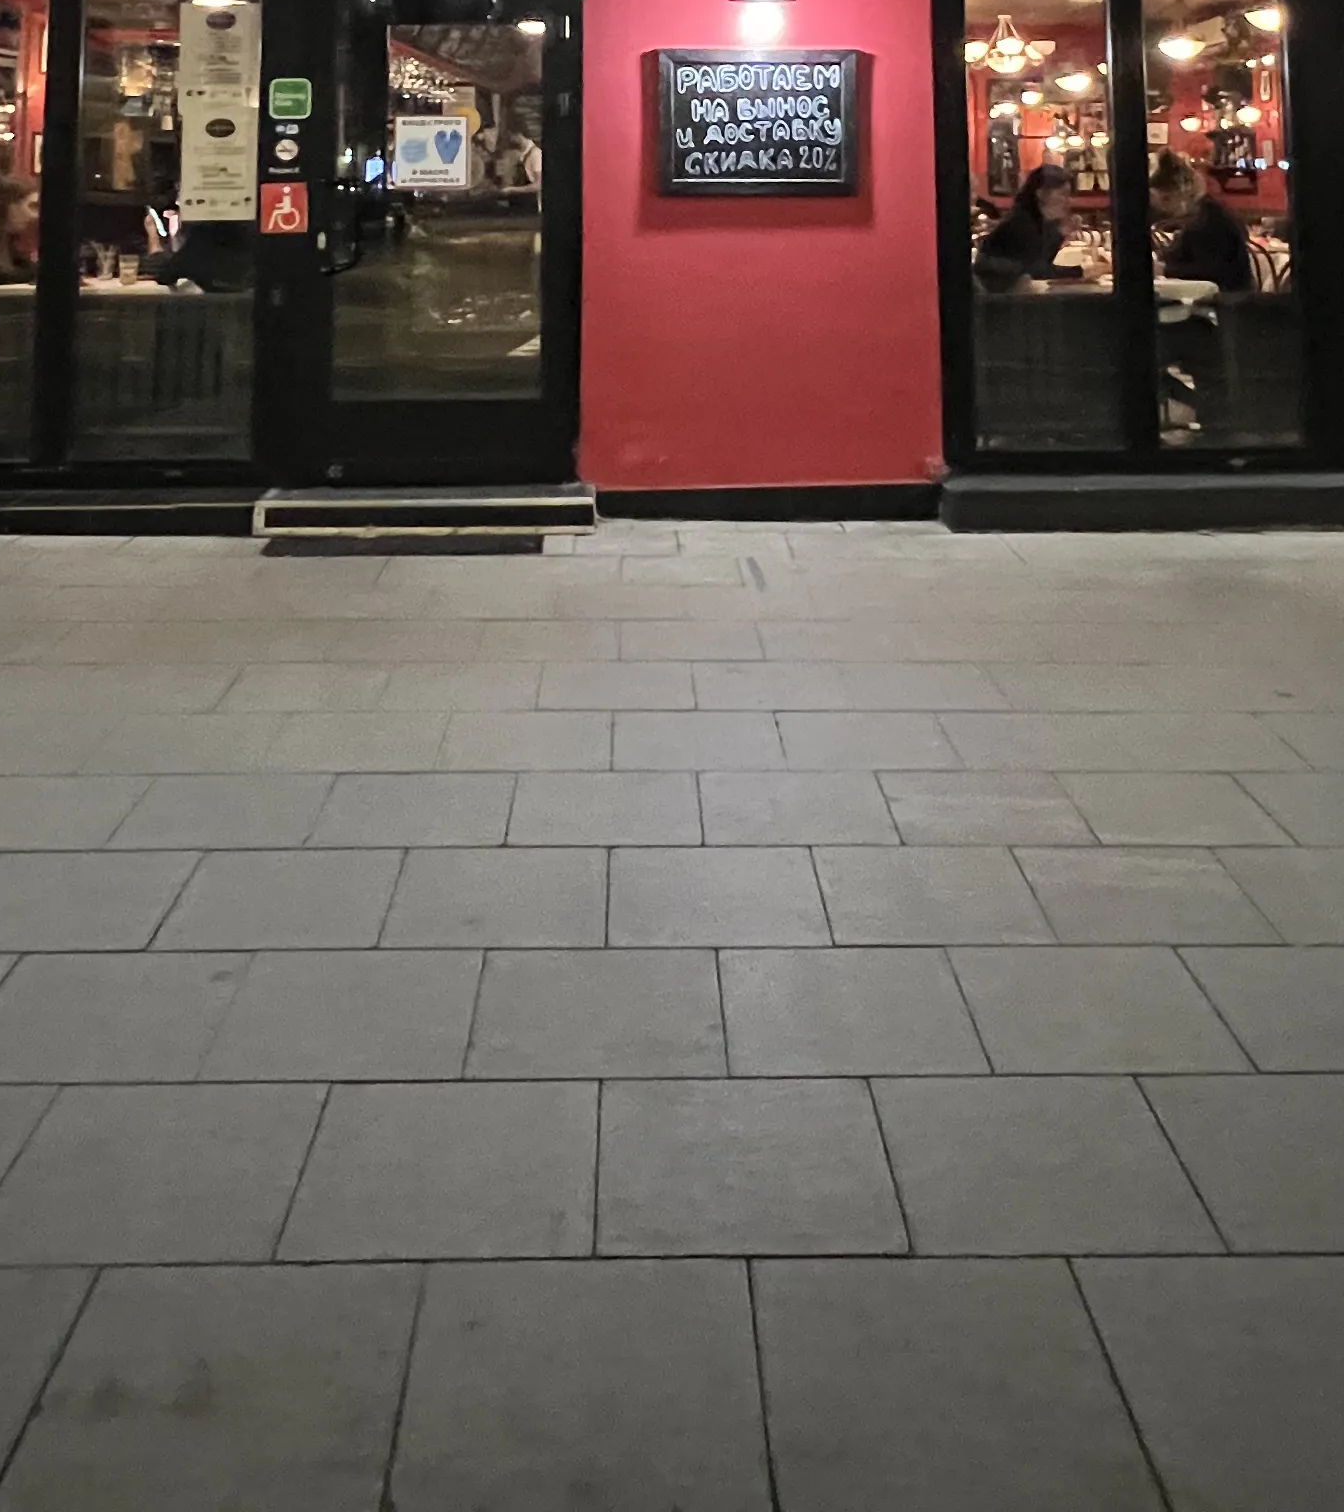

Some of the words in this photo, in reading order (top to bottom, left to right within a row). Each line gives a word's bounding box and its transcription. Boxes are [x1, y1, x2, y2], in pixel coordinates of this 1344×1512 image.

[676, 64, 841, 94] РАБОТАЕМ
[691, 98, 730, 122] НА
[736, 95, 830, 121] ВЫНОС
[703, 117, 843, 146] ДОСТАВКУ
[684, 148, 794, 175] СКИДКА
[798, 145, 838, 172] 20%
